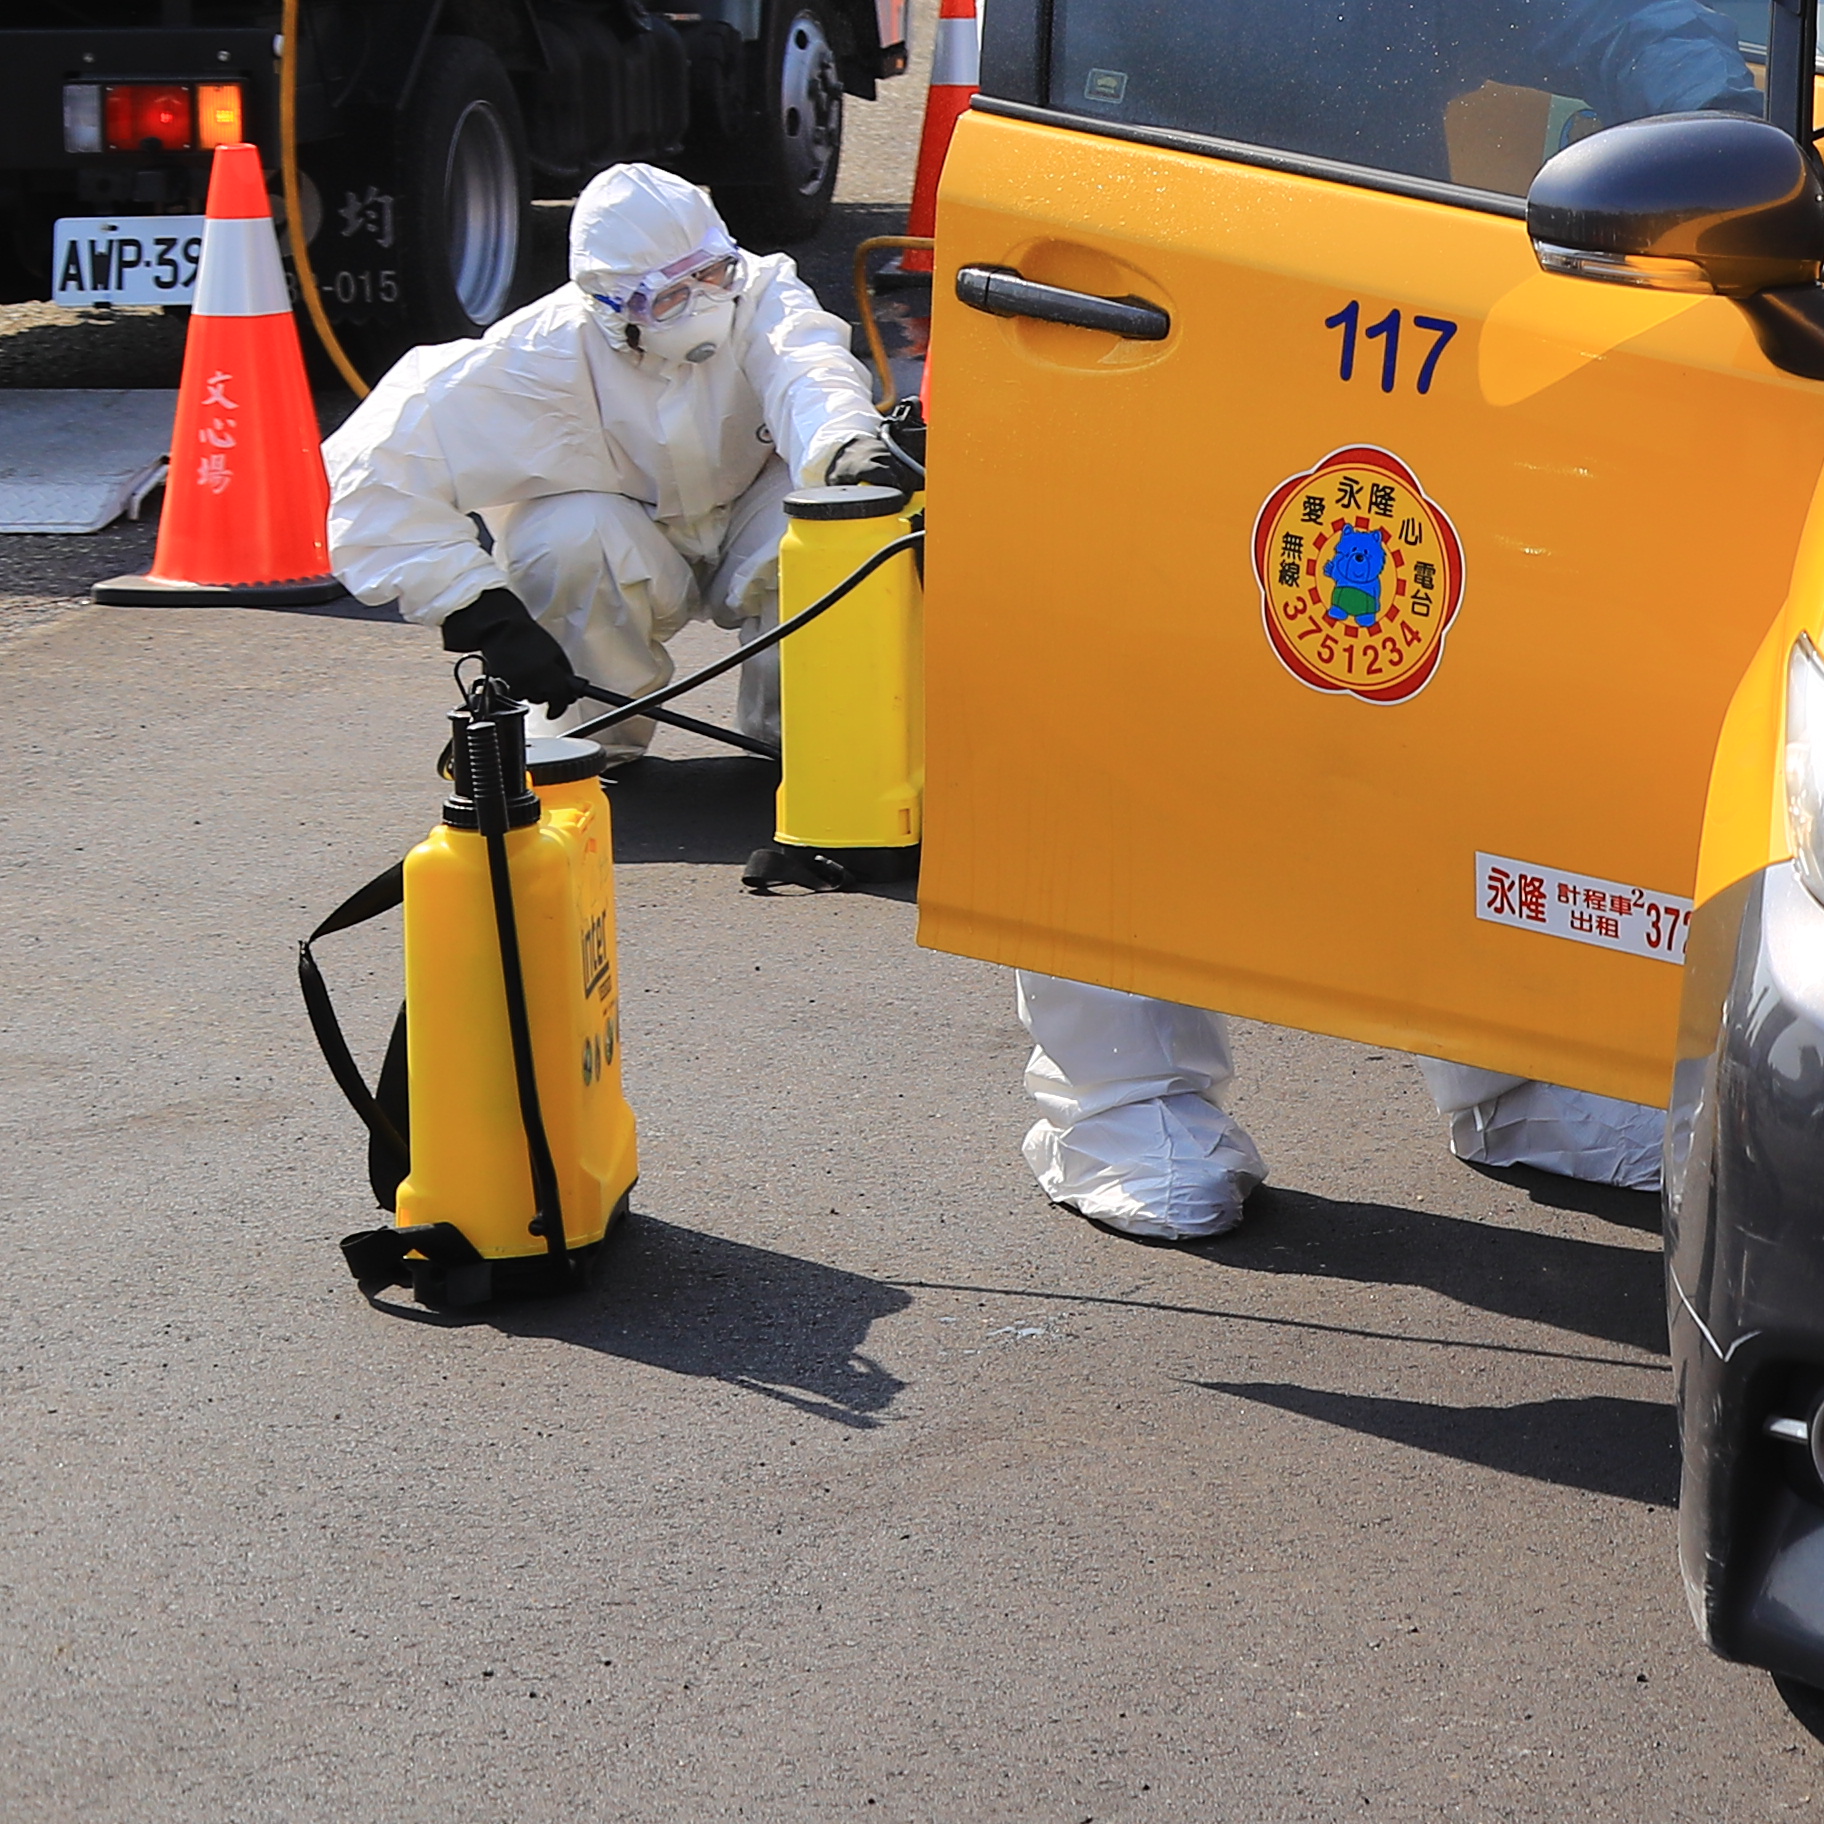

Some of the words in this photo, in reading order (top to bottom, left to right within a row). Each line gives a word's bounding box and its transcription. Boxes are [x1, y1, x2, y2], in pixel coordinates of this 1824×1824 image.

[338, 186, 394, 248] 均
[1324, 300, 1458, 394] 117
[197, 371, 239, 494] 文心場
[1301, 495, 1326, 526] 愛
[1335, 476, 1396, 518] 永隆
[1398, 517, 1422, 546] 心
[1278, 532, 1304, 588] 無線
[1411, 560, 1436, 618] 電台
[1283, 596, 1422, 675] 3751234
[1487, 866, 1547, 923] 永隆
[1557, 882, 1633, 917] 計程車
[1570, 910, 1620, 939] 出租
